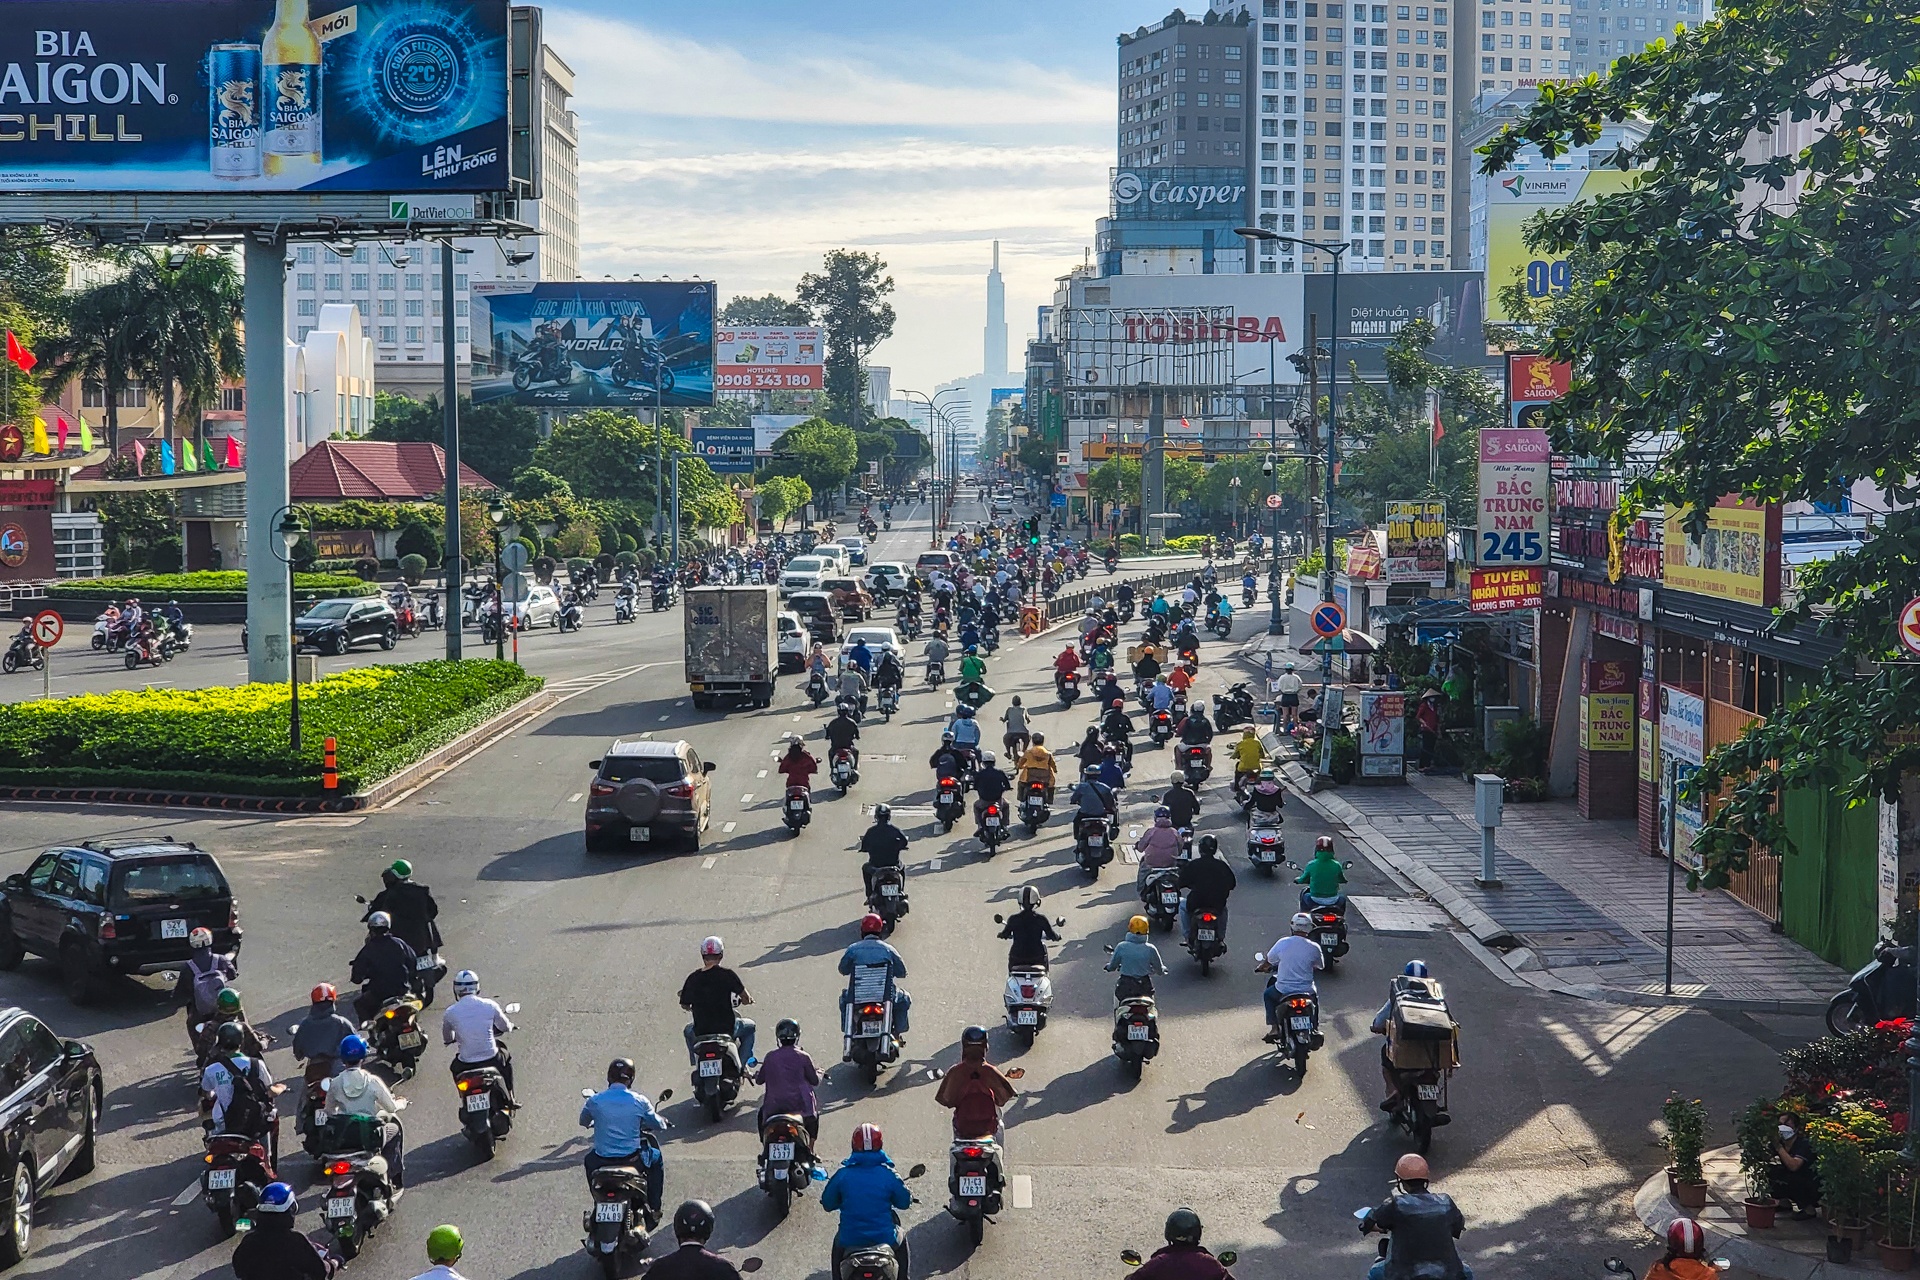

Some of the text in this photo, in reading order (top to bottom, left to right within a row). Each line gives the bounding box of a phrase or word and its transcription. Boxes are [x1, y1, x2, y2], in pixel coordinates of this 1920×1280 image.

[322, 16, 348, 35] MỚI
[35, 31, 97, 57] BIA
[391, 41, 451, 69] COLD FILTERED
[1518, 78, 1537, 87] NAM
[228, 119, 244, 128] BIA
[270, 111, 313, 123] SAIGON
[0, 114, 143, 142] CHILL
[211, 127, 260, 140] SAIGON
[422, 144, 462, 172] LÊN
[1524, 182, 1567, 190] VINAMA
[1149, 180, 1246, 210] Casper
[1351, 304, 1410, 320] Diệt khuẩn
[1123, 316, 1287, 344] TOSHIBA
[1350, 320, 1386, 337] MẠNH
[561, 339, 625, 351] WORLD
[717, 374, 811, 386] 0908 343 180
[1524, 389, 1558, 398] SAIGON
[1504, 443, 1543, 452] SAIGON
[1496, 473, 1532, 495] BẮC
[1401, 504, 1443, 515] Hoa Lan
[1483, 498, 1545, 513] TRUNG
[1389, 520, 1412, 539] Anh
[1493, 515, 1534, 530] NAM
[1482, 532, 1543, 561] 245
[1472, 585, 1500, 600] NHÂN
[1502, 583, 1526, 597] VIÊN
[1522, 597, 1542, 607] 20TR
[1600, 706, 1623, 719] BẮC
[1592, 721, 1631, 730] TRUNG
[1599, 732, 1624, 741] NAM
